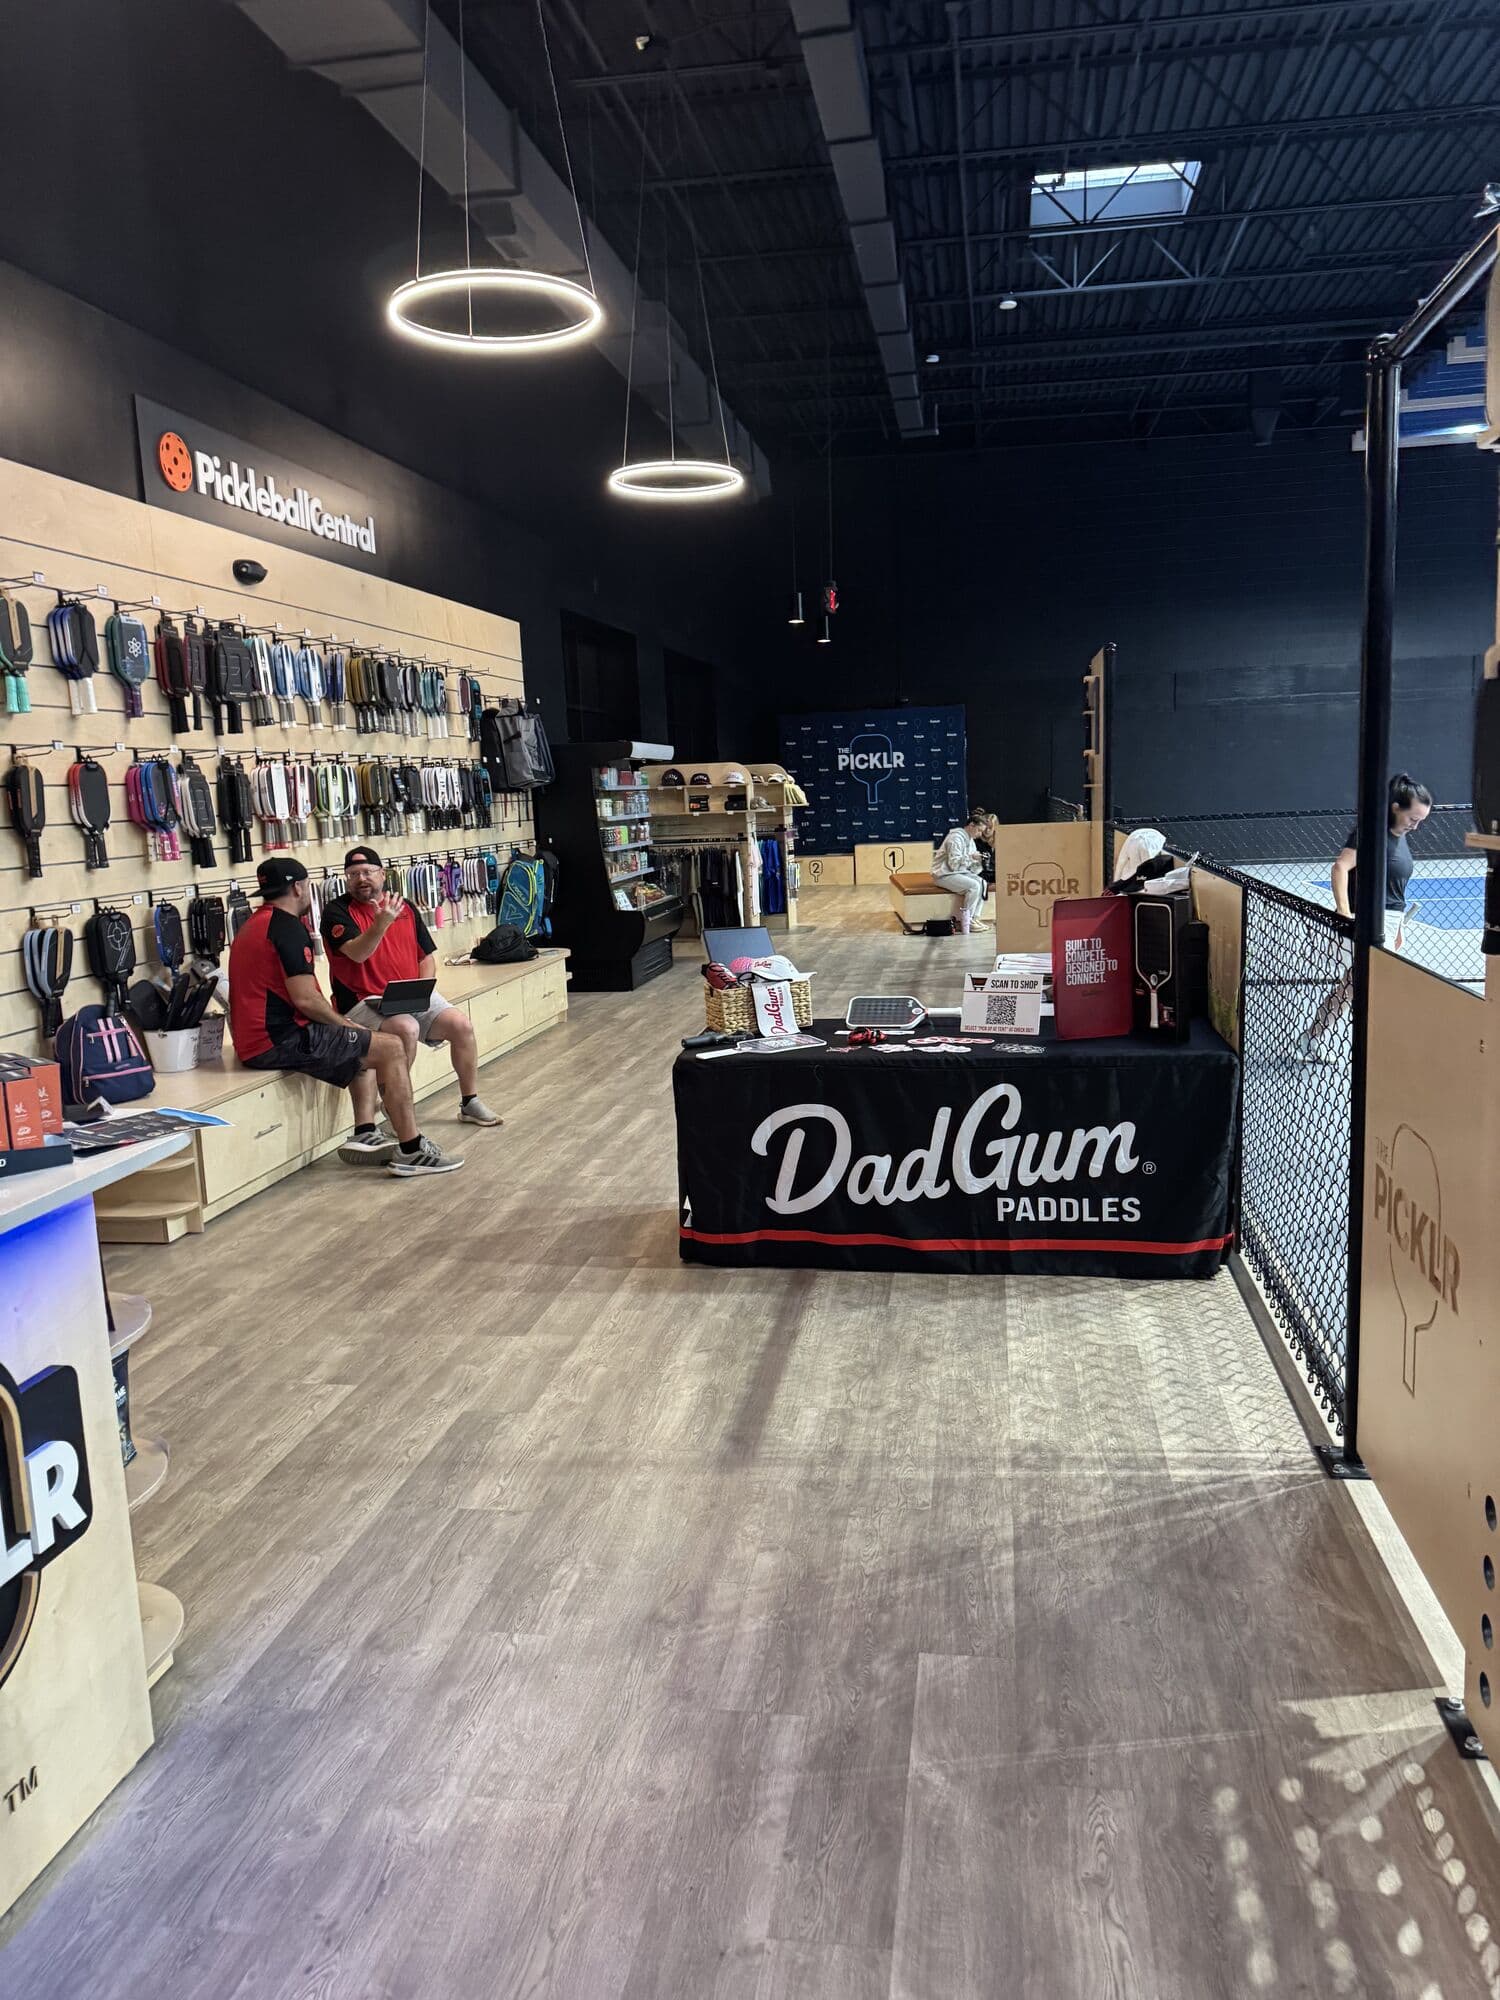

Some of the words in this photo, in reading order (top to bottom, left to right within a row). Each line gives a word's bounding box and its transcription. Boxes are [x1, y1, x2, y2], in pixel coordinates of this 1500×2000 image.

[195, 450, 377, 555] PickleballCentral
[837, 751, 906, 771] PICKLR
[812, 862, 820, 874] 2
[889, 850, 897, 868] 1
[1007, 872, 1021, 880] THE
[1007, 878, 1080, 897] PICKLR
[1065, 938, 1089, 952] BUILT
[1091, 937, 1102, 950] TO
[1065, 949, 1109, 963] COMPETE.
[1065, 960, 1106, 974] DESIGNED
[1107, 959, 1118, 971] TO
[990, 979, 1009, 989] SCAN
[1010, 980, 1019, 990] TO
[1020, 980, 1039, 990] SHOP
[1065, 971, 1107, 986] CONNECT.
[751, 1083, 1140, 1215] DadGum
[997, 1197, 1141, 1222] PADDLES
[1373, 1162, 1460, 1317] PICKLR
[3, 1765, 39, 1816] TM
